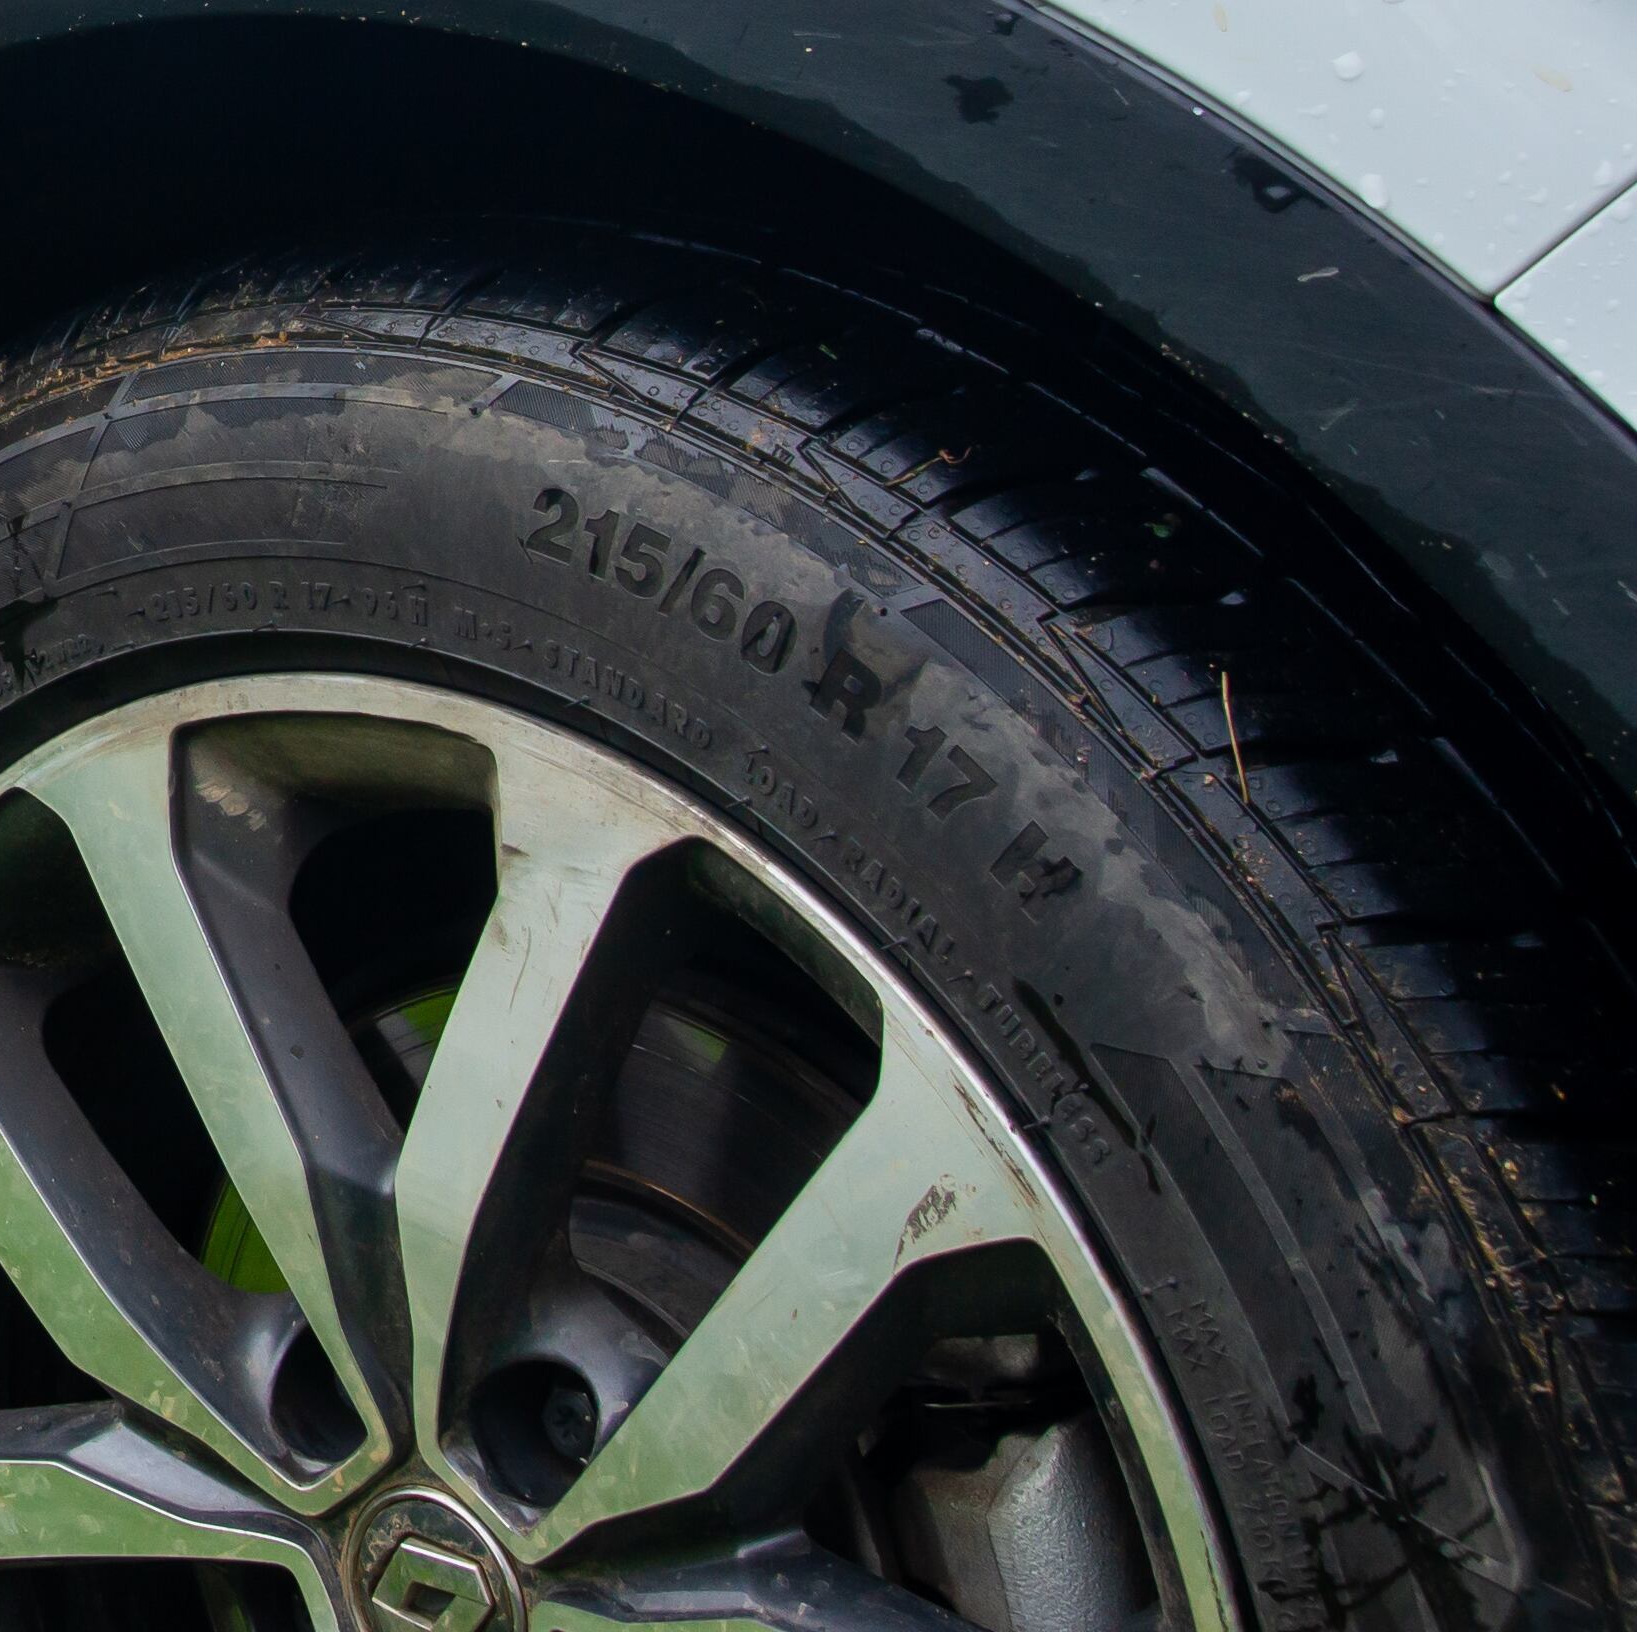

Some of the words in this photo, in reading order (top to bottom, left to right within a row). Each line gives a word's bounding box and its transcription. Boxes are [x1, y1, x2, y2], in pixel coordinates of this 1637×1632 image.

[526, 487, 799, 675] 215/60
[810, 648, 883, 744] R
[903, 724, 996, 820] 17
[543, 642, 712, 749] STANDARD
